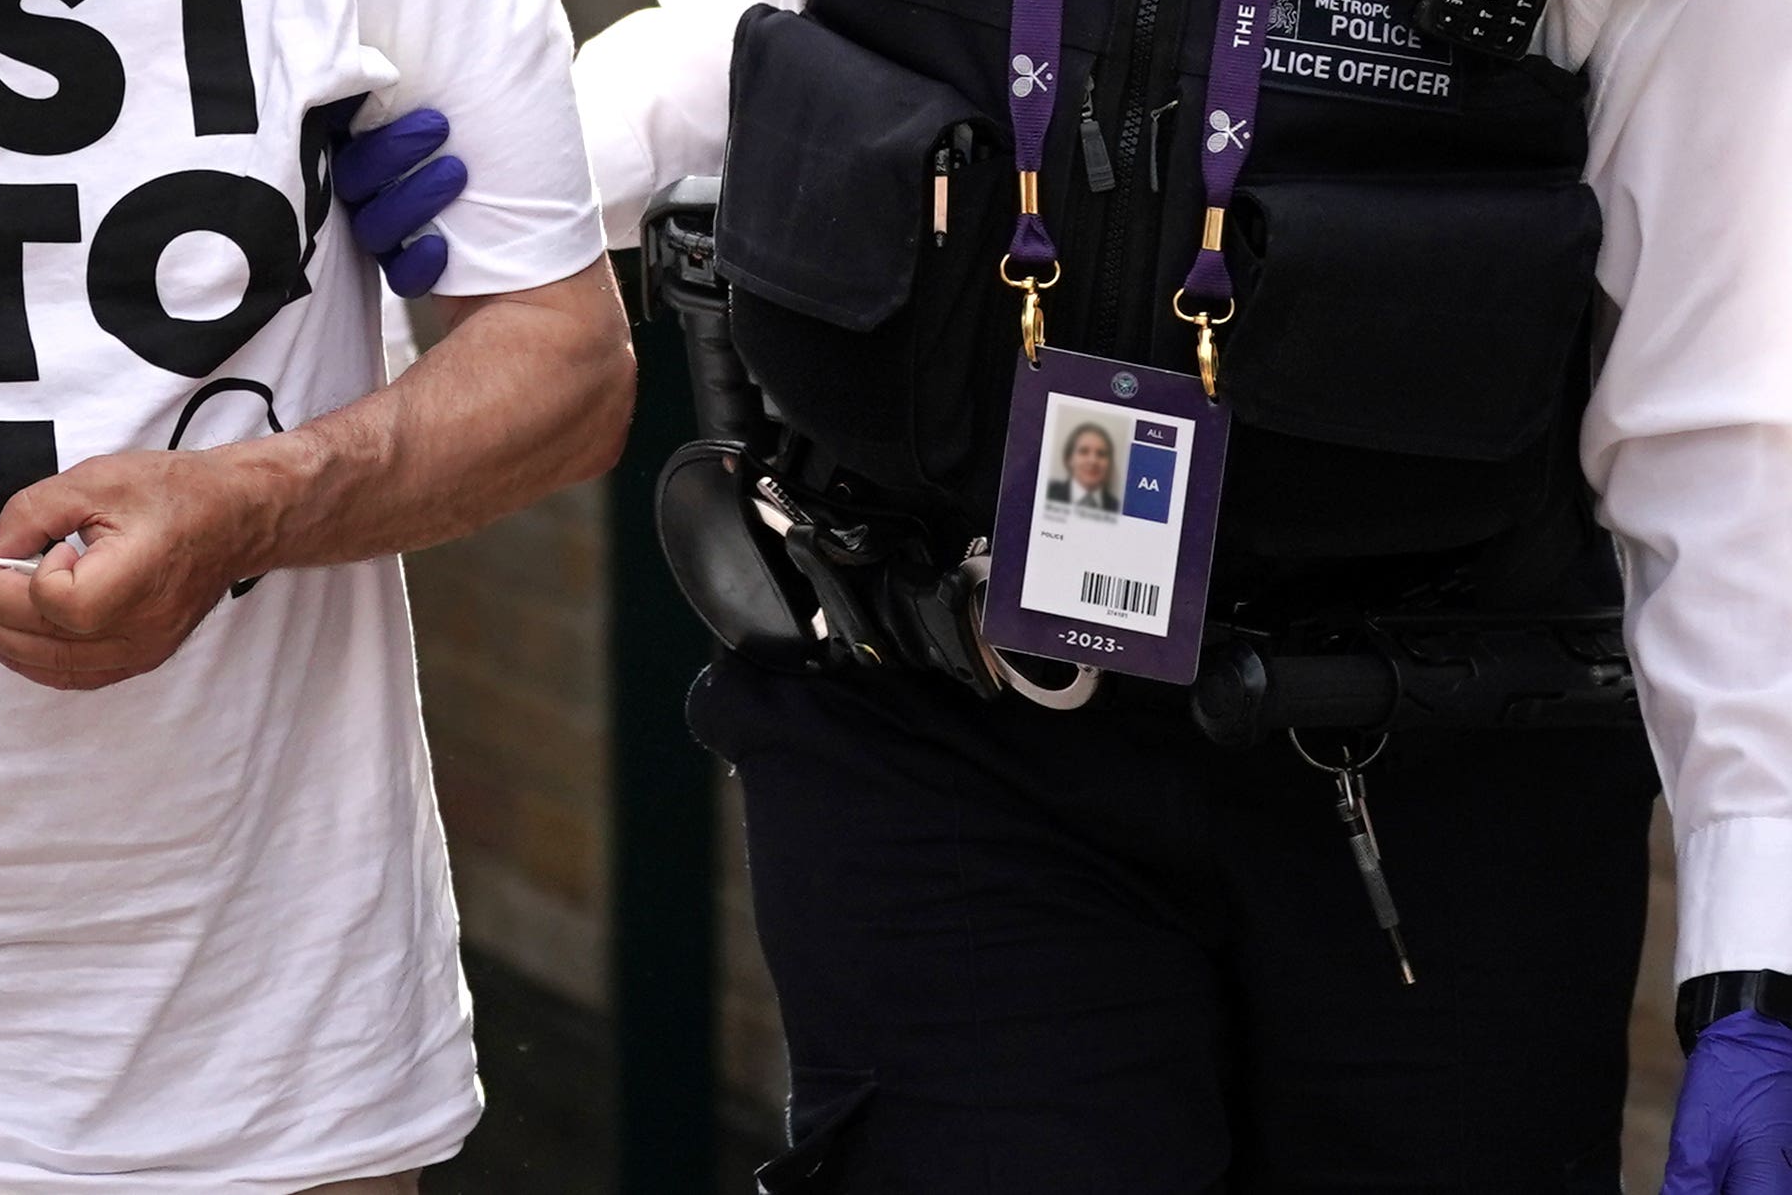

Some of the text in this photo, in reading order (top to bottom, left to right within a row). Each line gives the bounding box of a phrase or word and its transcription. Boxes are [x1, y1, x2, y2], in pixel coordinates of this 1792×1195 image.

[1233, 4, 1257, 48] THE
[1331, 15, 1422, 49] POLICE
[1337, 59, 1451, 97] OFFICER
[1147, 429, 1164, 439] ALL
[1138, 477, 1159, 492] AA
[1041, 531, 1064, 541] POLICE
